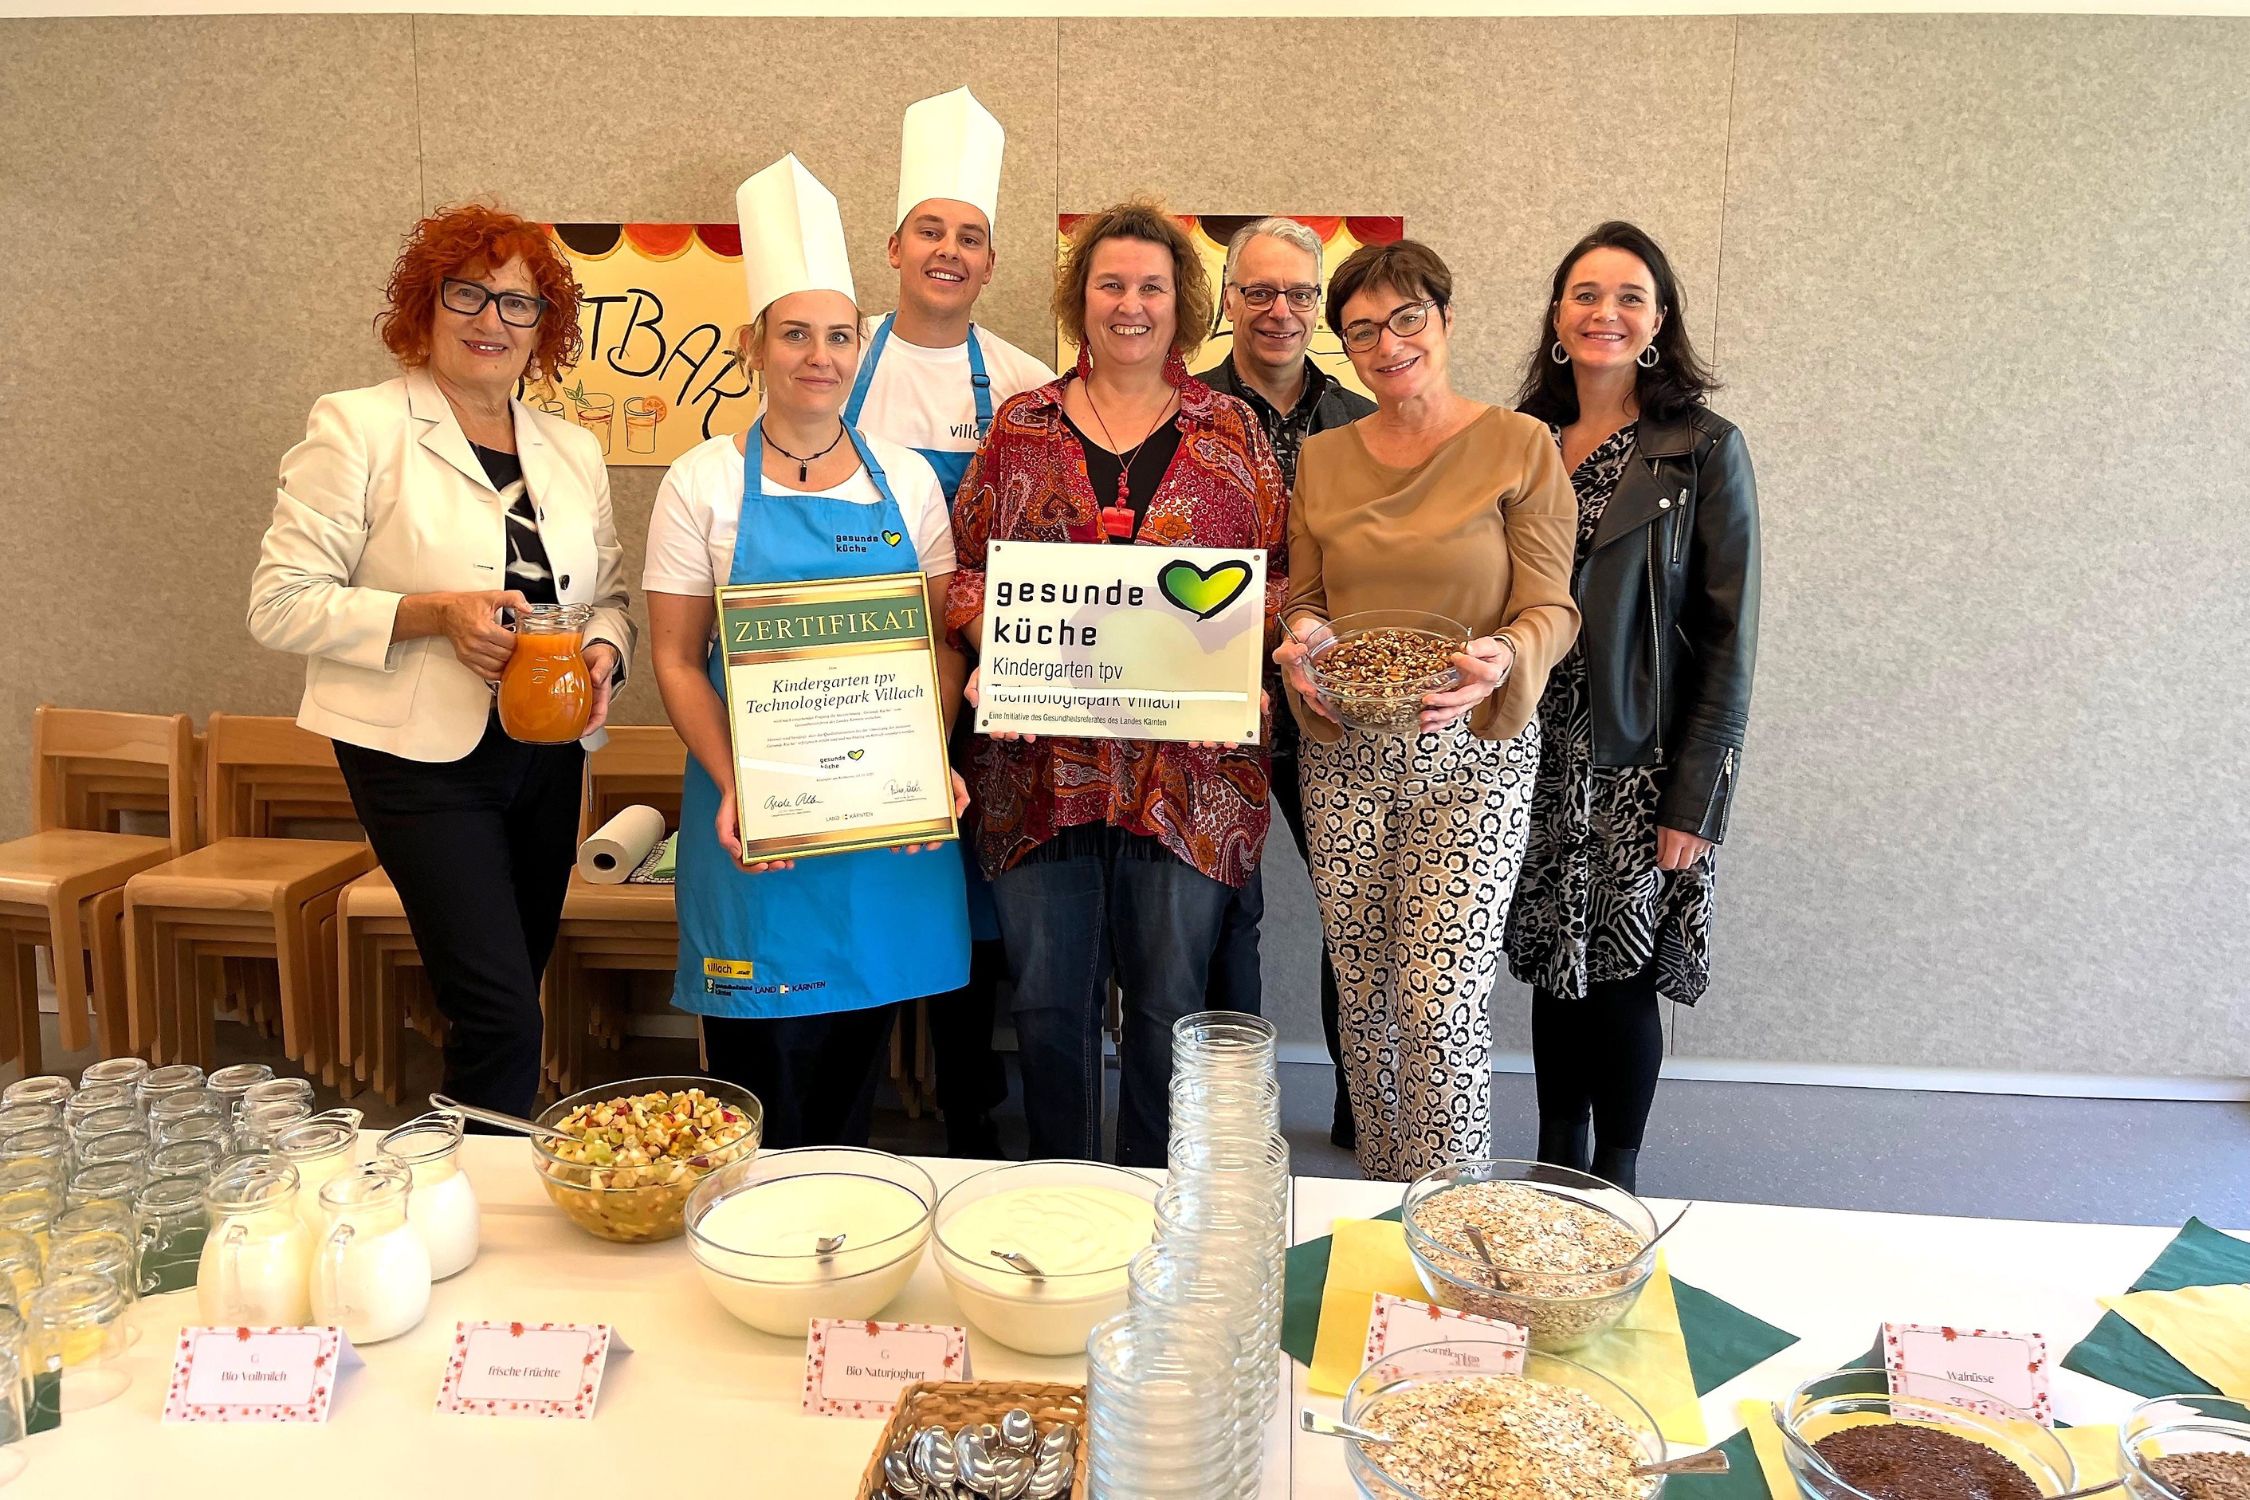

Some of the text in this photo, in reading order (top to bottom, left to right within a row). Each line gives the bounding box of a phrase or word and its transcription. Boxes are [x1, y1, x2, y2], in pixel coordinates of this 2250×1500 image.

[580, 288, 754, 441] TBAR
[949, 423, 980, 440] villa
[835, 534, 879, 543] gesunde
[836, 544, 867, 553] küche
[996, 578, 1144, 607] gesunde
[735, 607, 919, 643] ZERTIFIKAT
[994, 616, 1097, 647] küche
[992, 657, 1123, 683] Kindergarten tpv
[772, 672, 896, 694] Kindergarten tpv
[746, 684, 924, 714] Technologiepark Villach
[988, 711, 1002, 720] Eine
[1004, 711, 1030, 721] Initiative
[1107, 715, 1119, 725] des
[1120, 716, 1142, 725] Landes
[1143, 717, 1167, 727] Kärnten
[755, 981, 826, 995] LAND KÄRNTEN
[221, 1370, 239, 1382] Bio
[846, 1365, 926, 1381] Bio Naturjoghurt
[1946, 1369, 1995, 1384] Walnüsse
